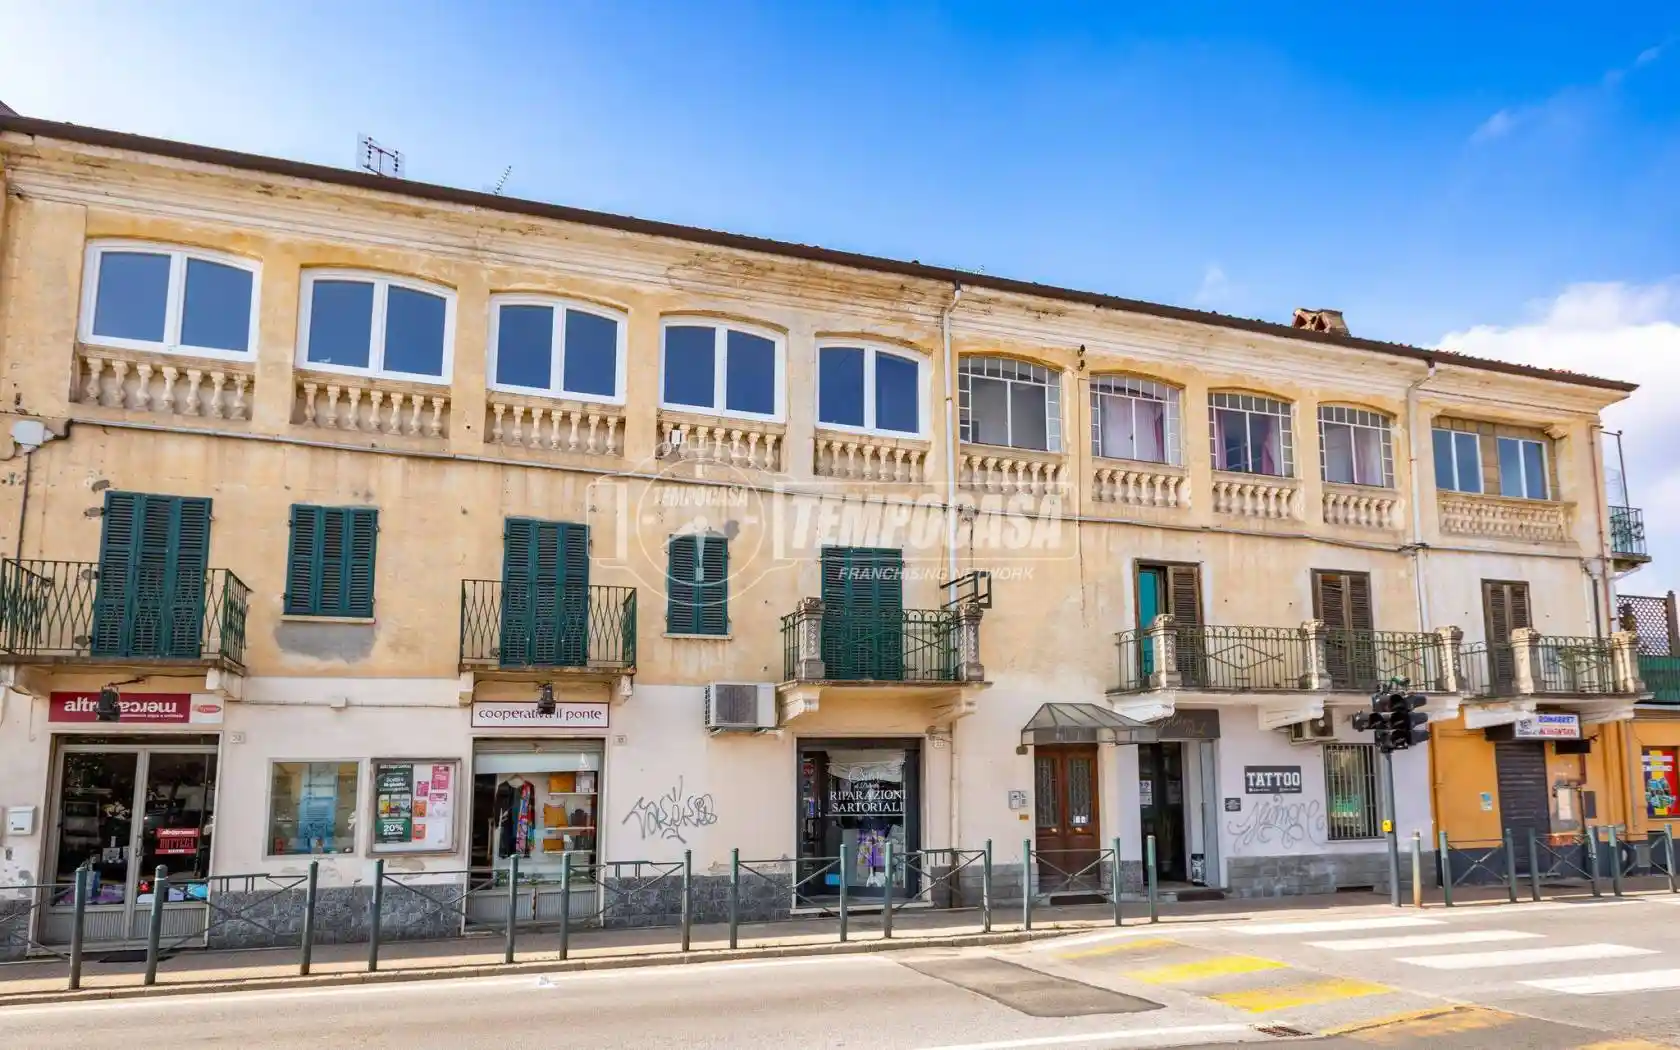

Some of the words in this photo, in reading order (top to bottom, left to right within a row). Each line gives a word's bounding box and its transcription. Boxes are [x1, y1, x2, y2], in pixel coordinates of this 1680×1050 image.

[64, 697, 101, 712] altr
[556, 708, 563, 719] il
[565, 708, 602, 721] ponte
[1246, 772, 1300, 786] TATTOO
[830, 789, 906, 801] RIPARAZIONI
[831, 801, 905, 813] SARTORIALI
[383, 824, 404, 832] 20%
